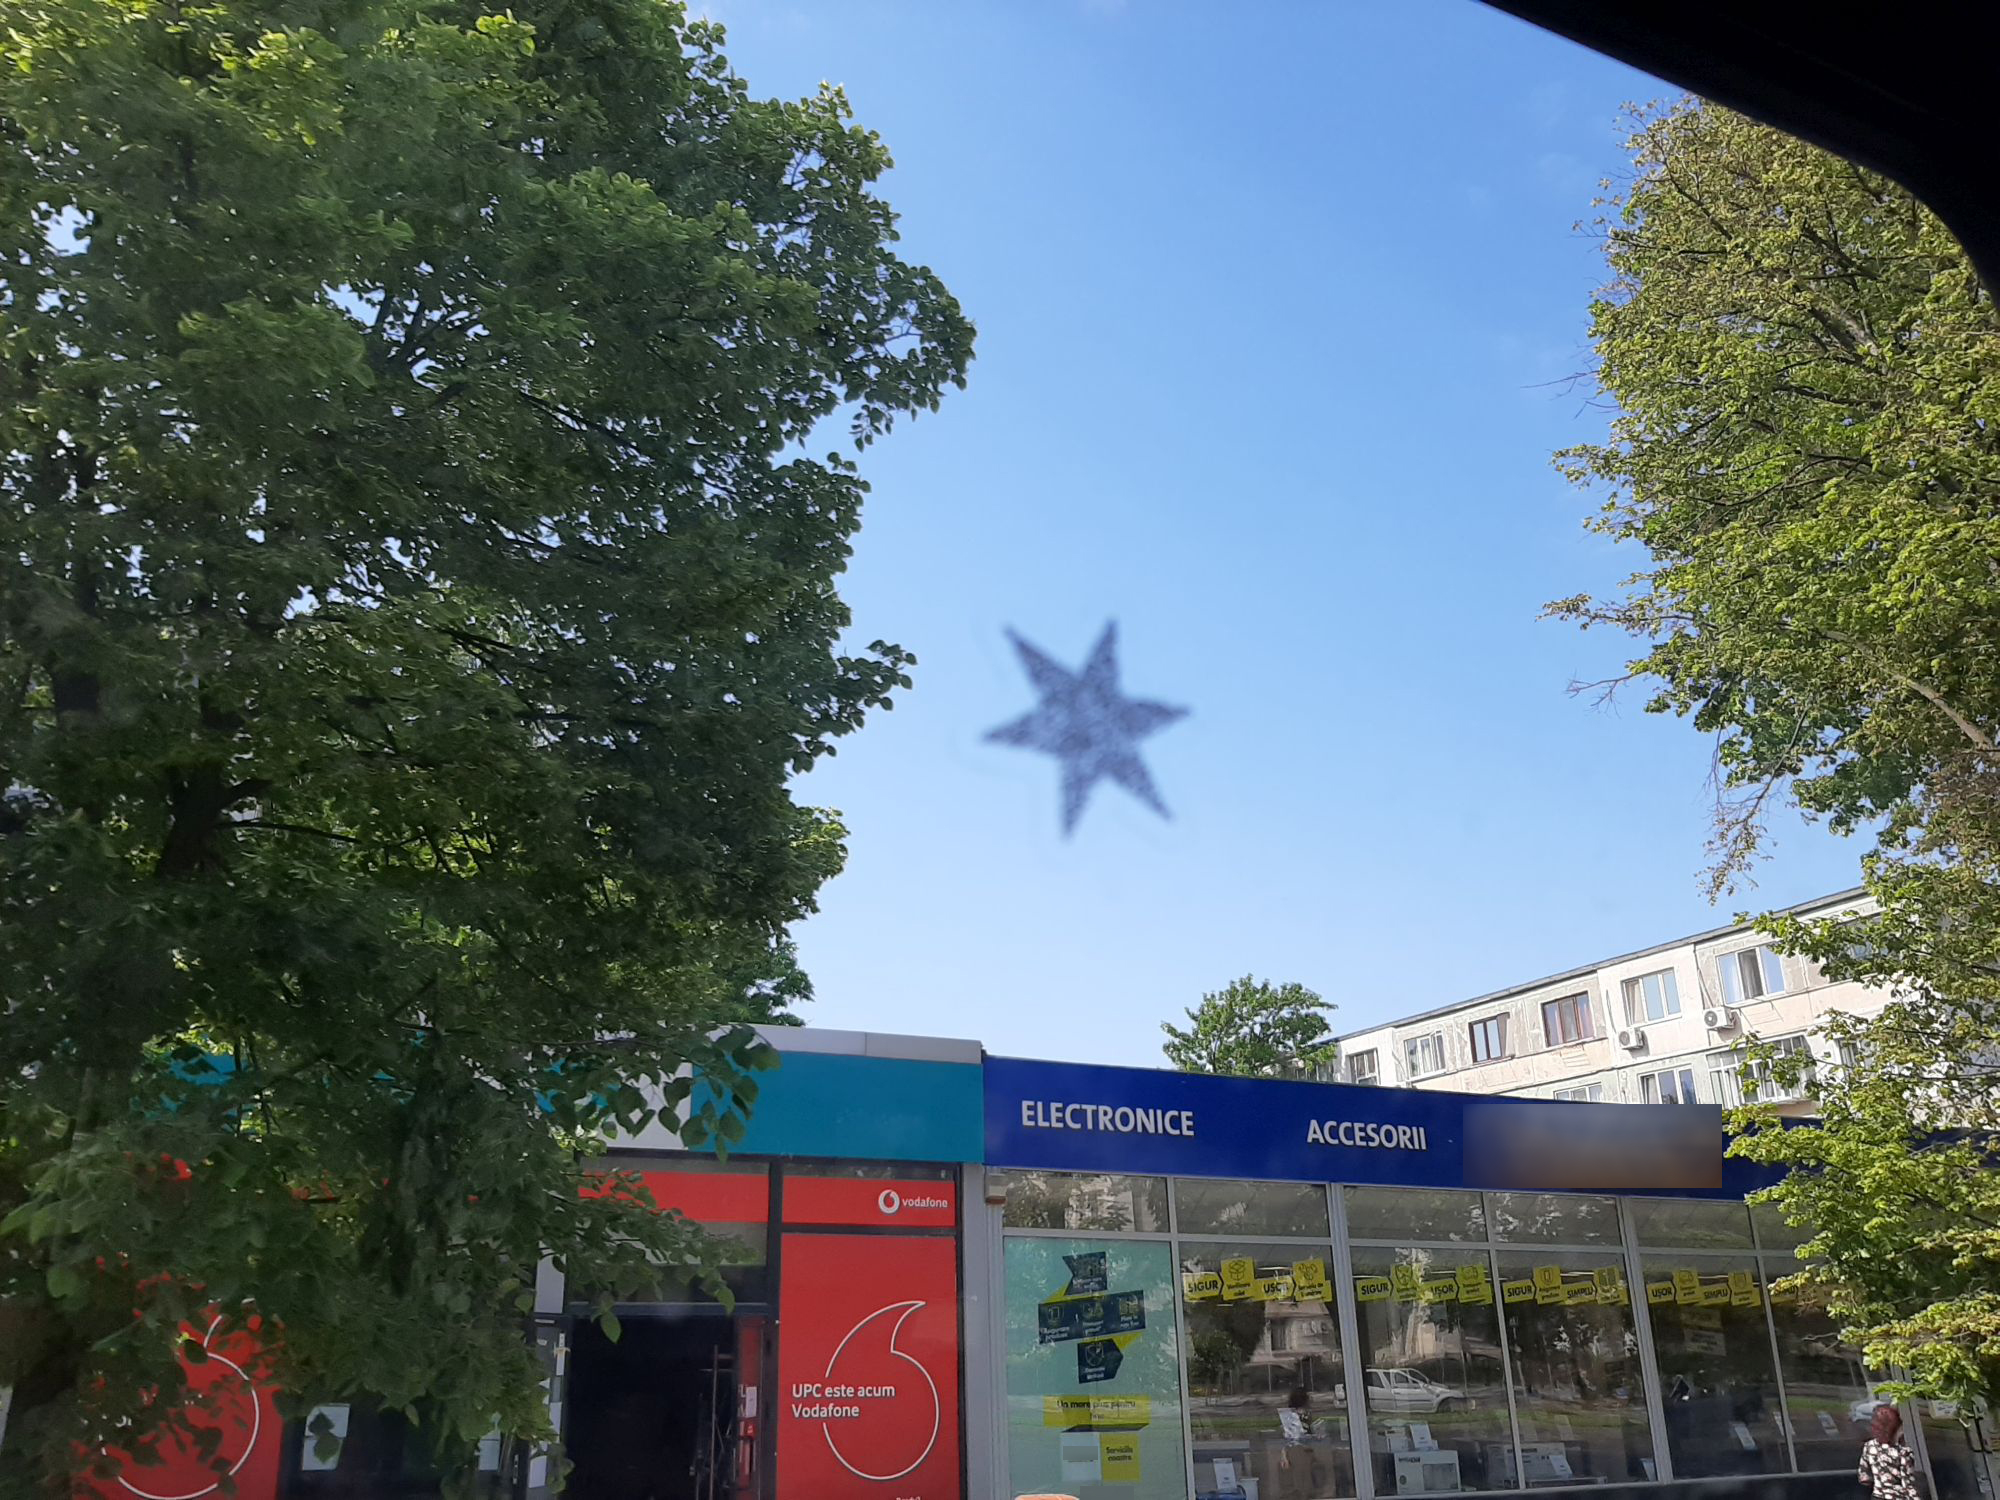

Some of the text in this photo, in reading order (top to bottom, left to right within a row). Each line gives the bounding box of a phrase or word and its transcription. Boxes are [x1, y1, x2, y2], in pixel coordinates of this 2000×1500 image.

[1021, 1100, 1428, 1151] ELECTRONICE ACCESORII
[901, 1196, 949, 1208] vodafone
[1188, 1280, 1219, 1292] SIGUR
[1361, 1282, 1390, 1295] SIGUR
[1507, 1285, 1532, 1297] SIGUR
[792, 1384, 895, 1397] UPC este acum
[791, 1403, 859, 1418] Vodafone
